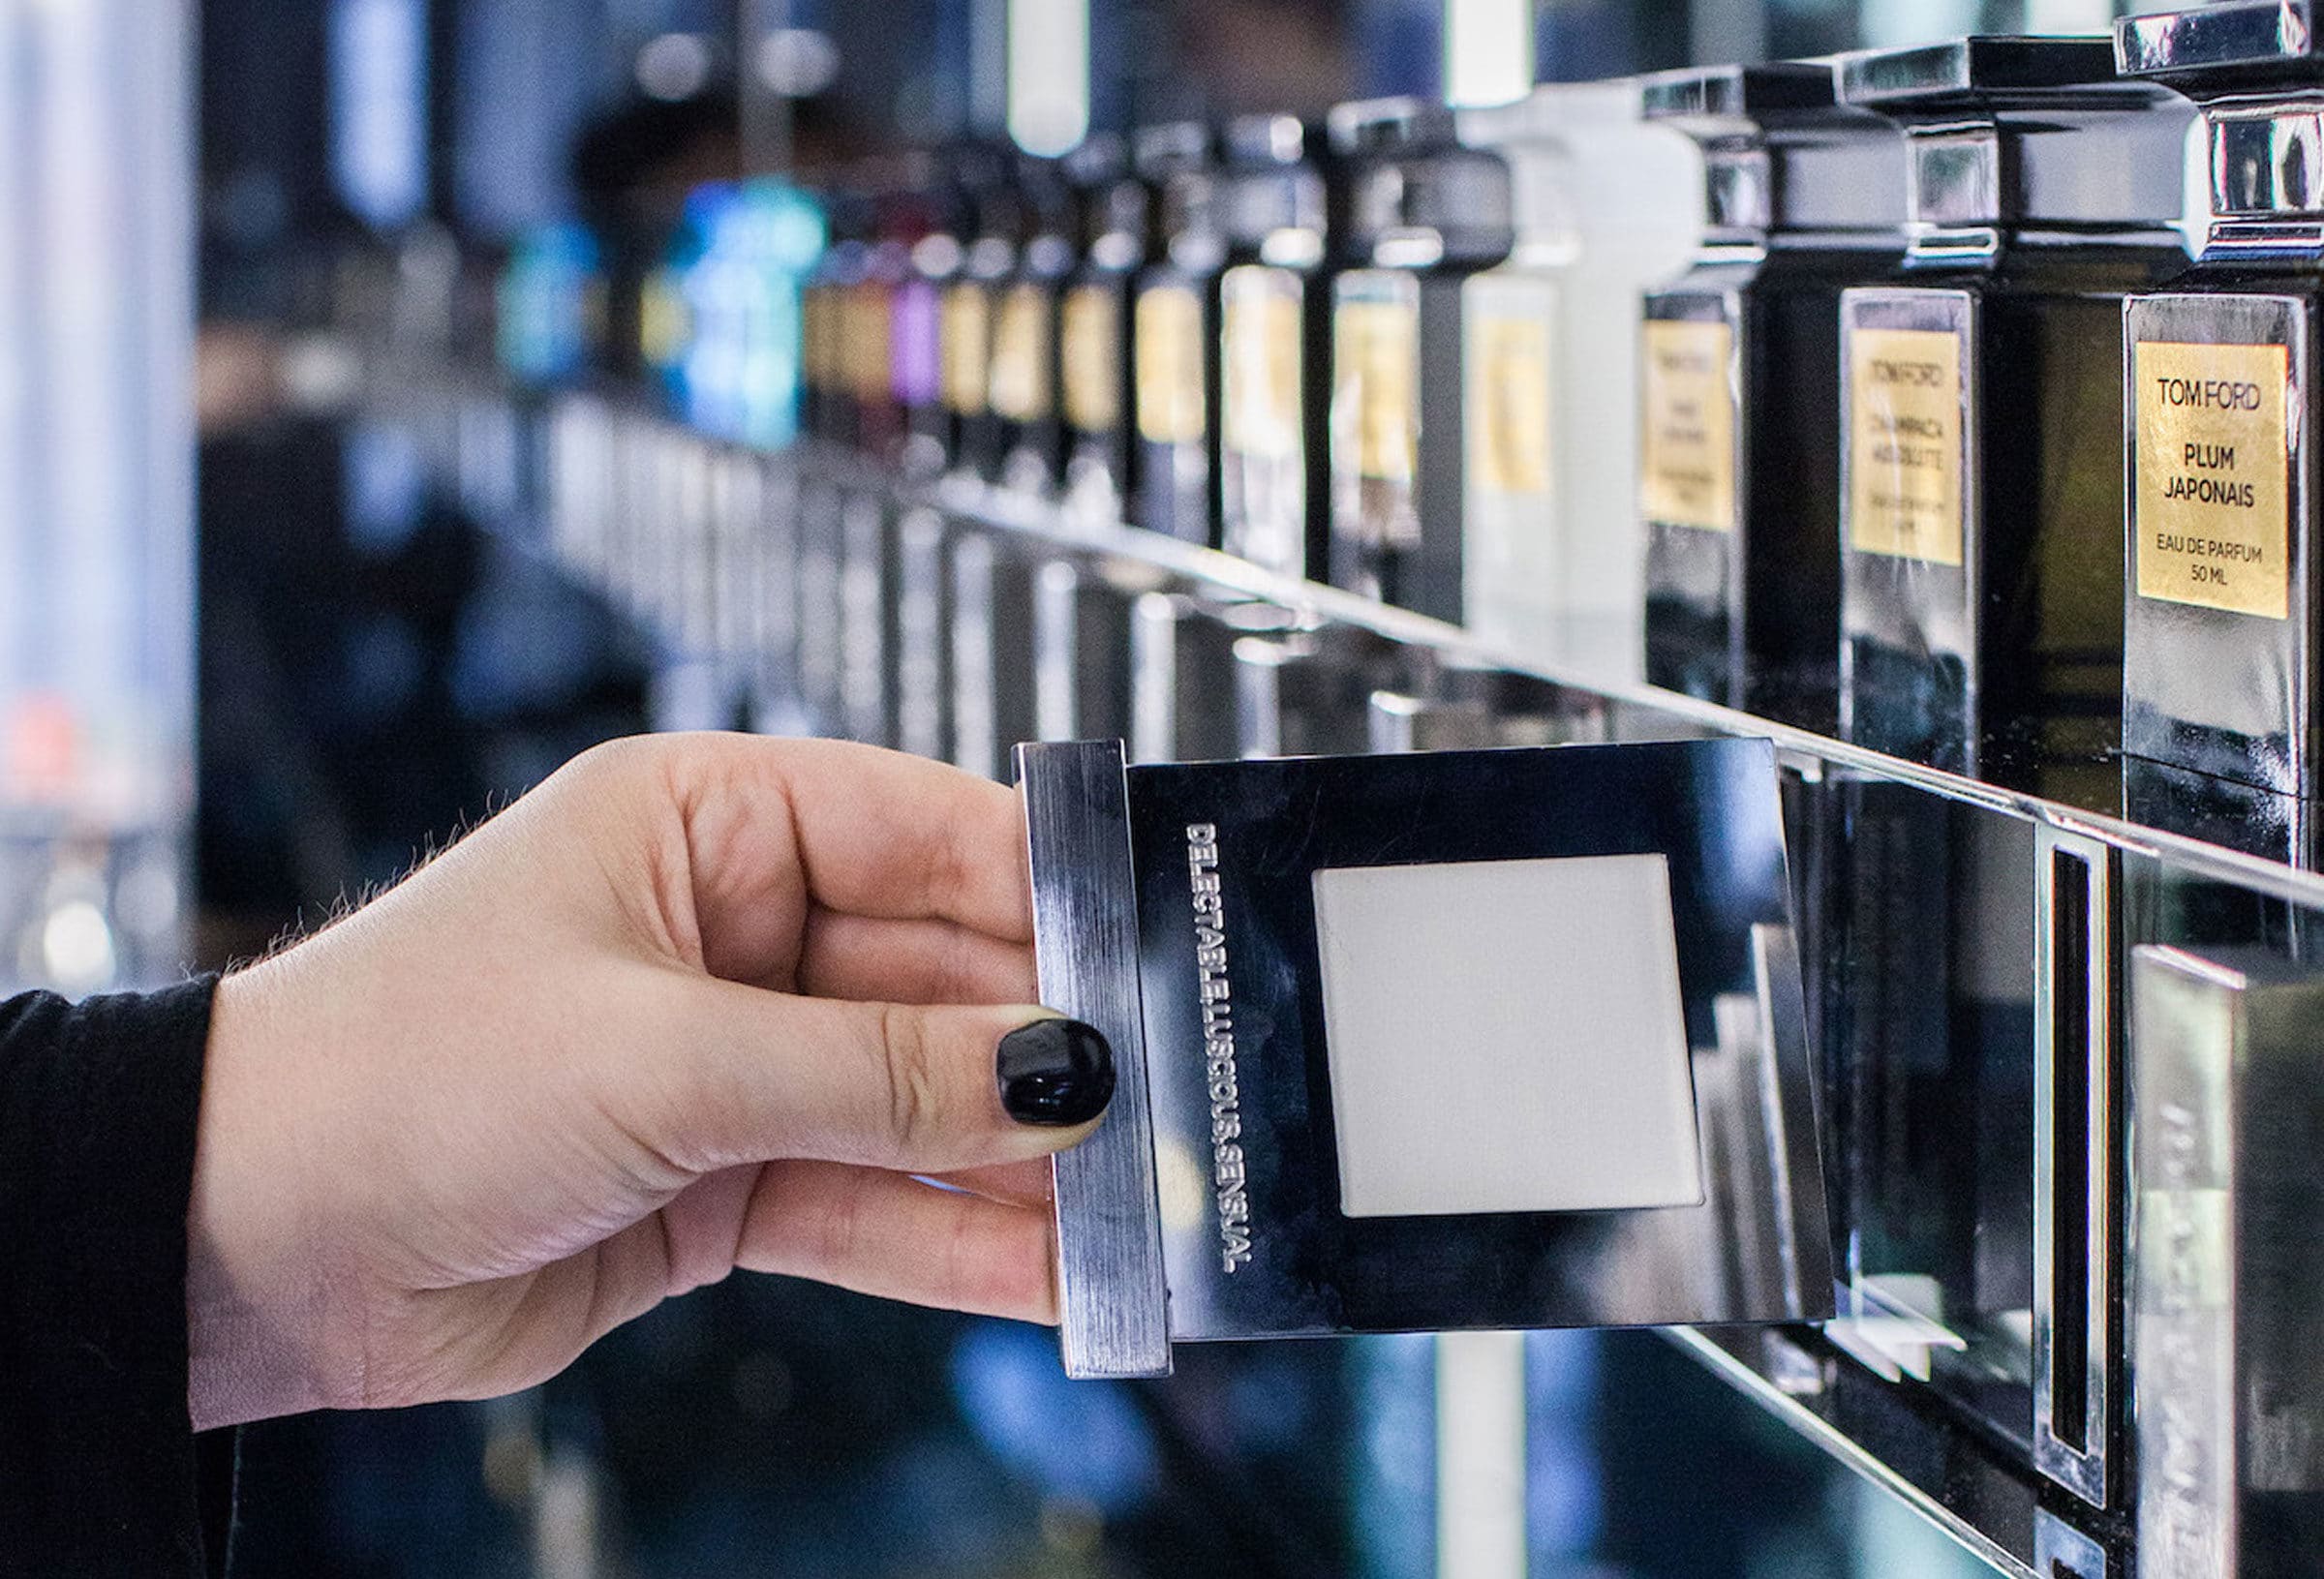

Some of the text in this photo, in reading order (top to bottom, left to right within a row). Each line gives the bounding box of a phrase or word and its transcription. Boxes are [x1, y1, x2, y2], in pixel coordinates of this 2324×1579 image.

[2156, 378, 2262, 411] TOM FORD
[2184, 442, 2235, 471] PLUM
[2164, 476, 2255, 508] JAPONAIS
[2156, 532, 2263, 564] EAU DE PARFUM
[2190, 563, 2228, 586] 50 ML
[1214, 1143, 1252, 1274] SENSUAL
